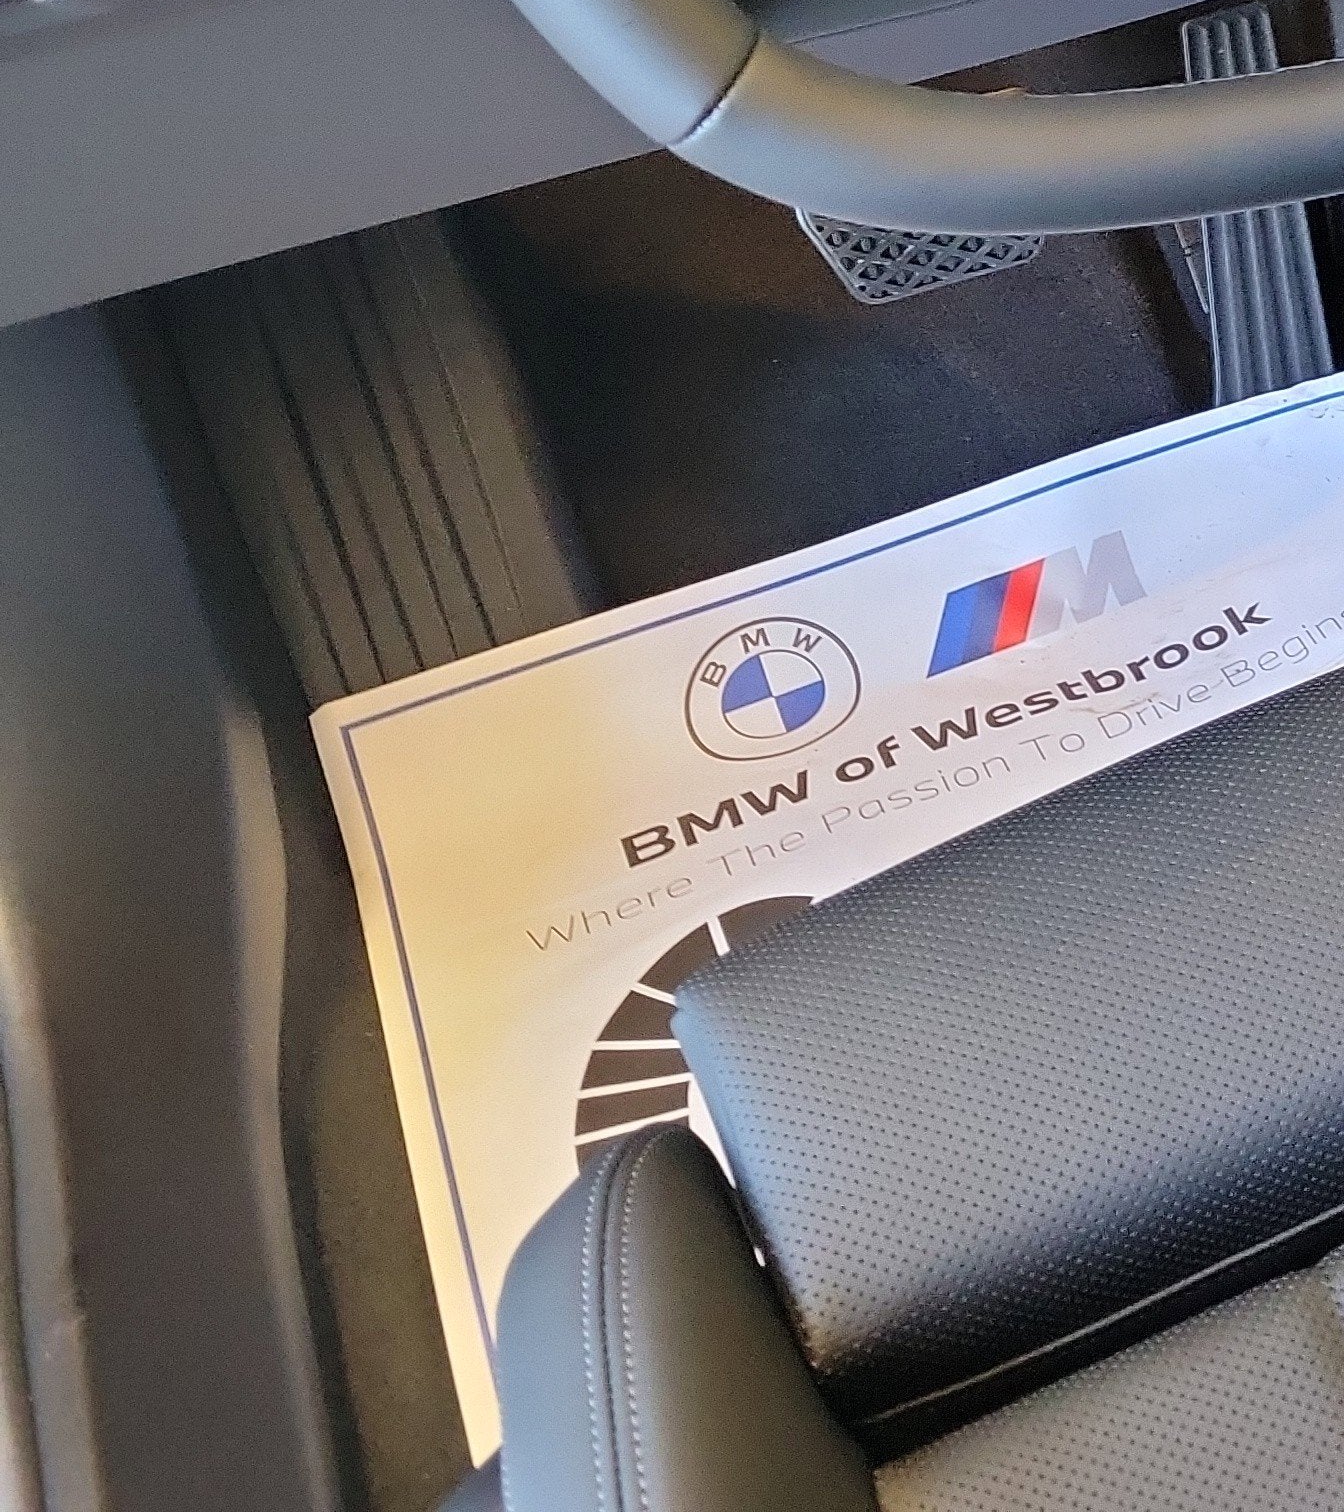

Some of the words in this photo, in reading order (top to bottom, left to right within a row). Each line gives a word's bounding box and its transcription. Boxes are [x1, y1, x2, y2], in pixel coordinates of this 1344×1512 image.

[620, 769, 809, 868] BMW
[835, 735, 900, 784] of
[911, 602, 1271, 752] Westbrook
[700, 626, 823, 688] BMW
[526, 877, 694, 952] Where
[707, 832, 807, 877] The
[820, 752, 1009, 835] Passion
[1019, 731, 1085, 762] To
[1097, 680, 1212, 741] Drive
